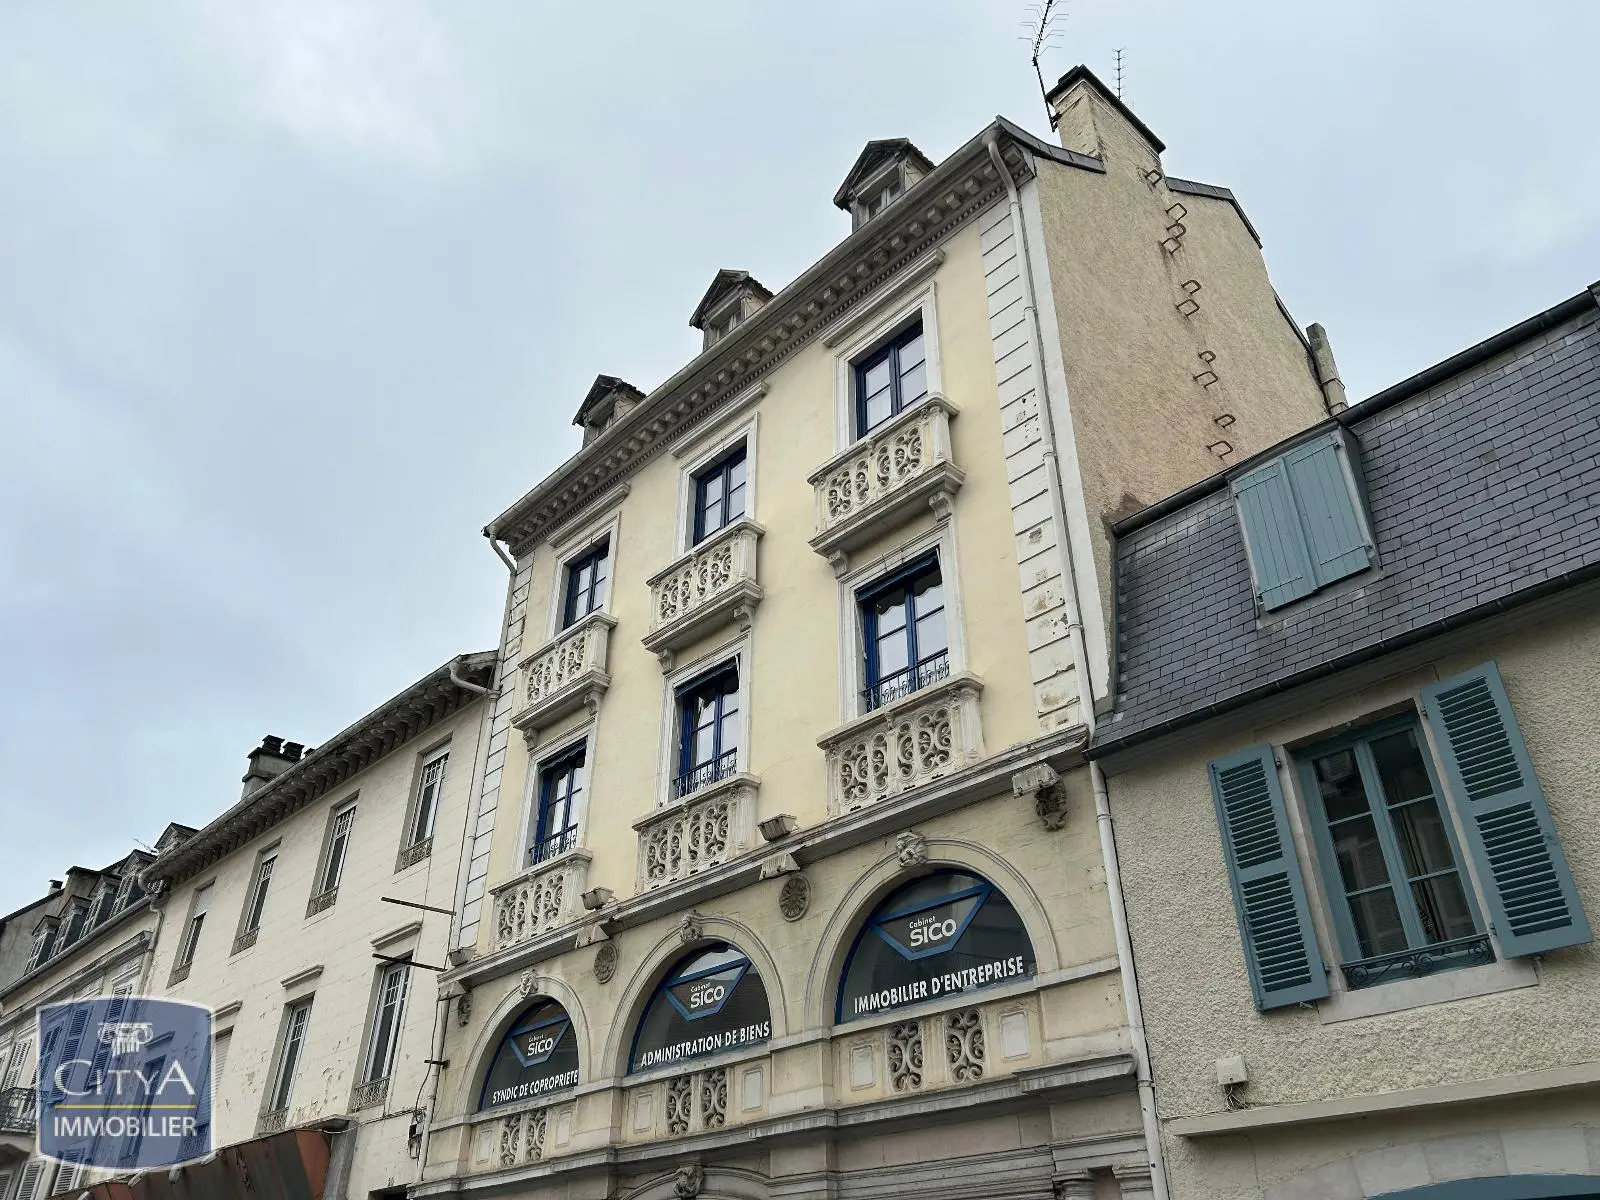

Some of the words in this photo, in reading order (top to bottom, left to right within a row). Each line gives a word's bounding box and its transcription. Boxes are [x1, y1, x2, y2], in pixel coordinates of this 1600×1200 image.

[909, 915, 936, 928] Cabinet
[910, 918, 957, 947] SICO
[691, 986, 725, 1008] SICO
[854, 980, 928, 1014] IMMOBILIER
[932, 955, 1024, 993] D'ENTREPRISE
[527, 1038, 553, 1056] SICO
[640, 1034, 722, 1068] ADMINISTRATION
[725, 1029, 737, 1046] DE
[740, 1020, 770, 1042] BIENS
[492, 1085, 518, 1104] SYNDIC
[519, 1083, 529, 1097] DE
[529, 1069, 579, 1094] COPROPRIETE
